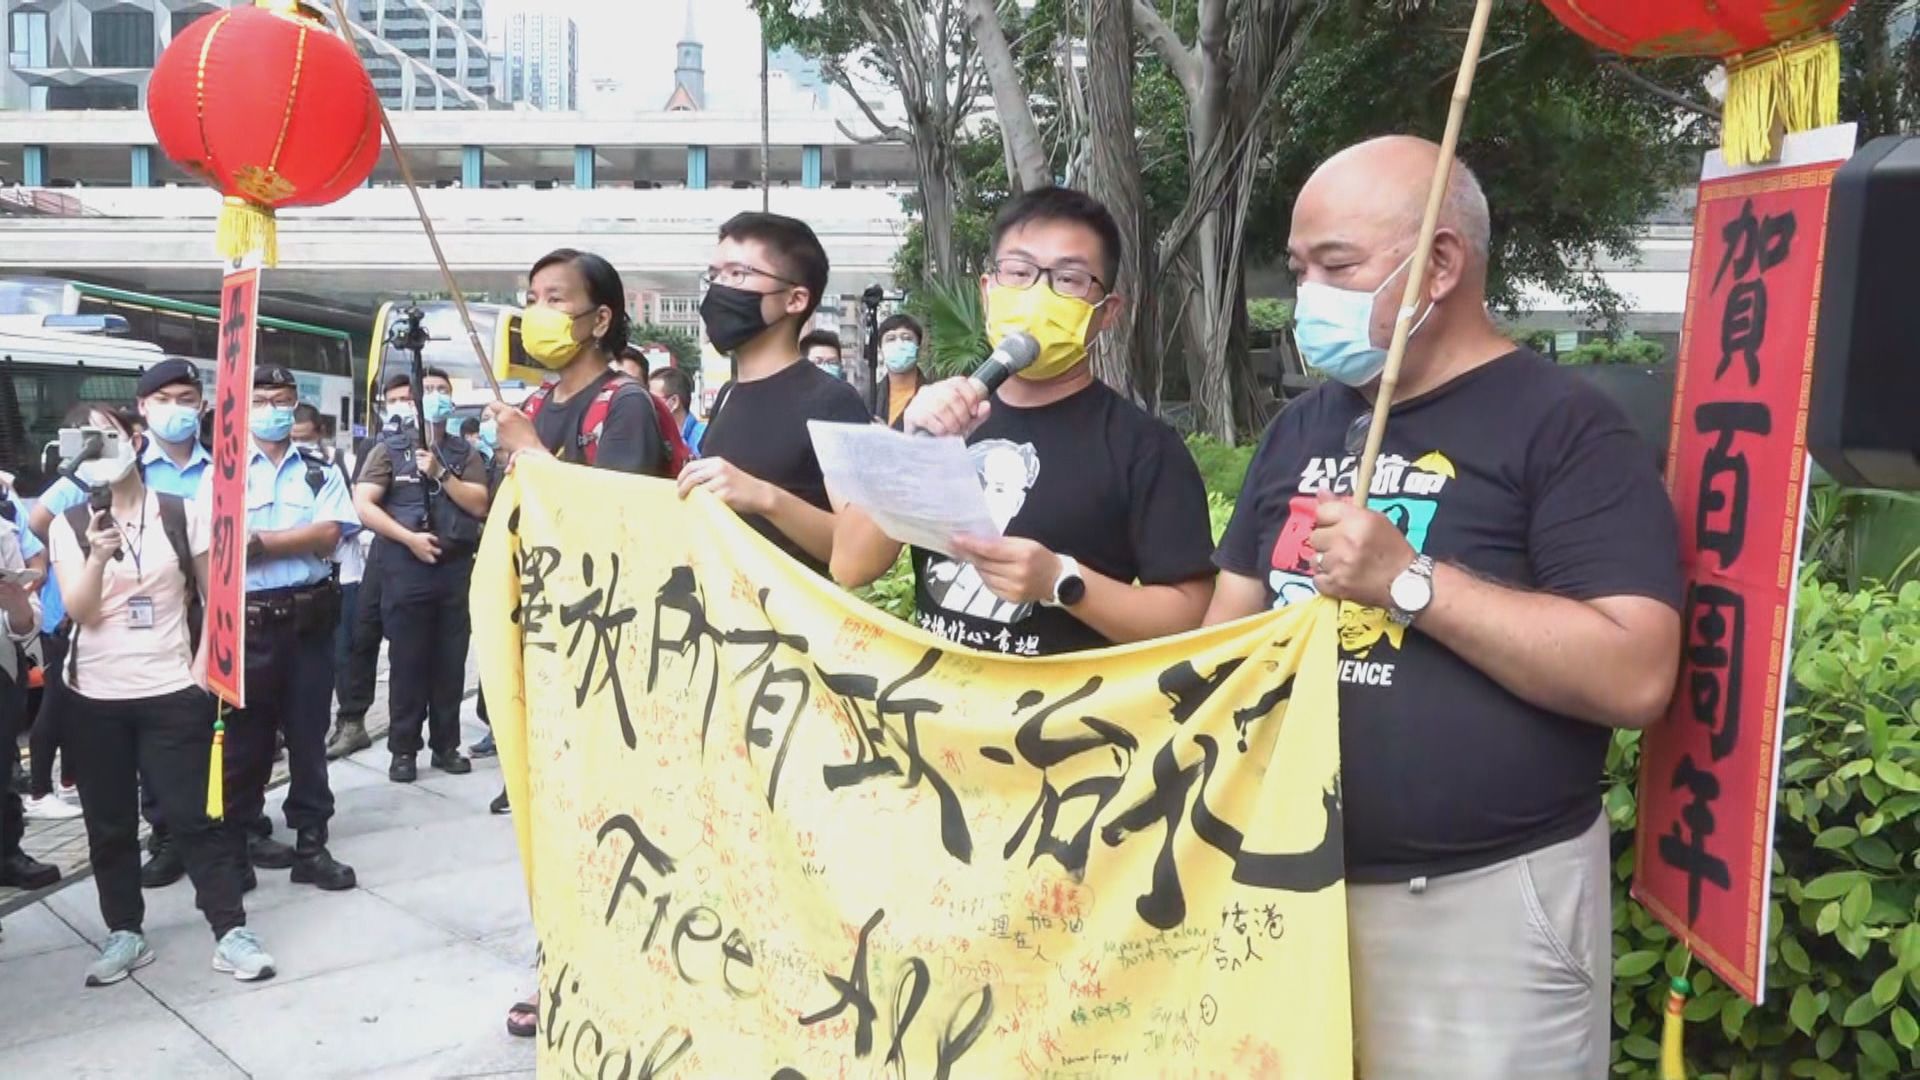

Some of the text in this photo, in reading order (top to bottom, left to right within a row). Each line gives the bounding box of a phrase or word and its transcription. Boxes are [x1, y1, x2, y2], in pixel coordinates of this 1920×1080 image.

[209, 287, 246, 678] 毋忘初心
[1658, 198, 1795, 922] 賀百周年
[597, 813, 762, 998] Free
